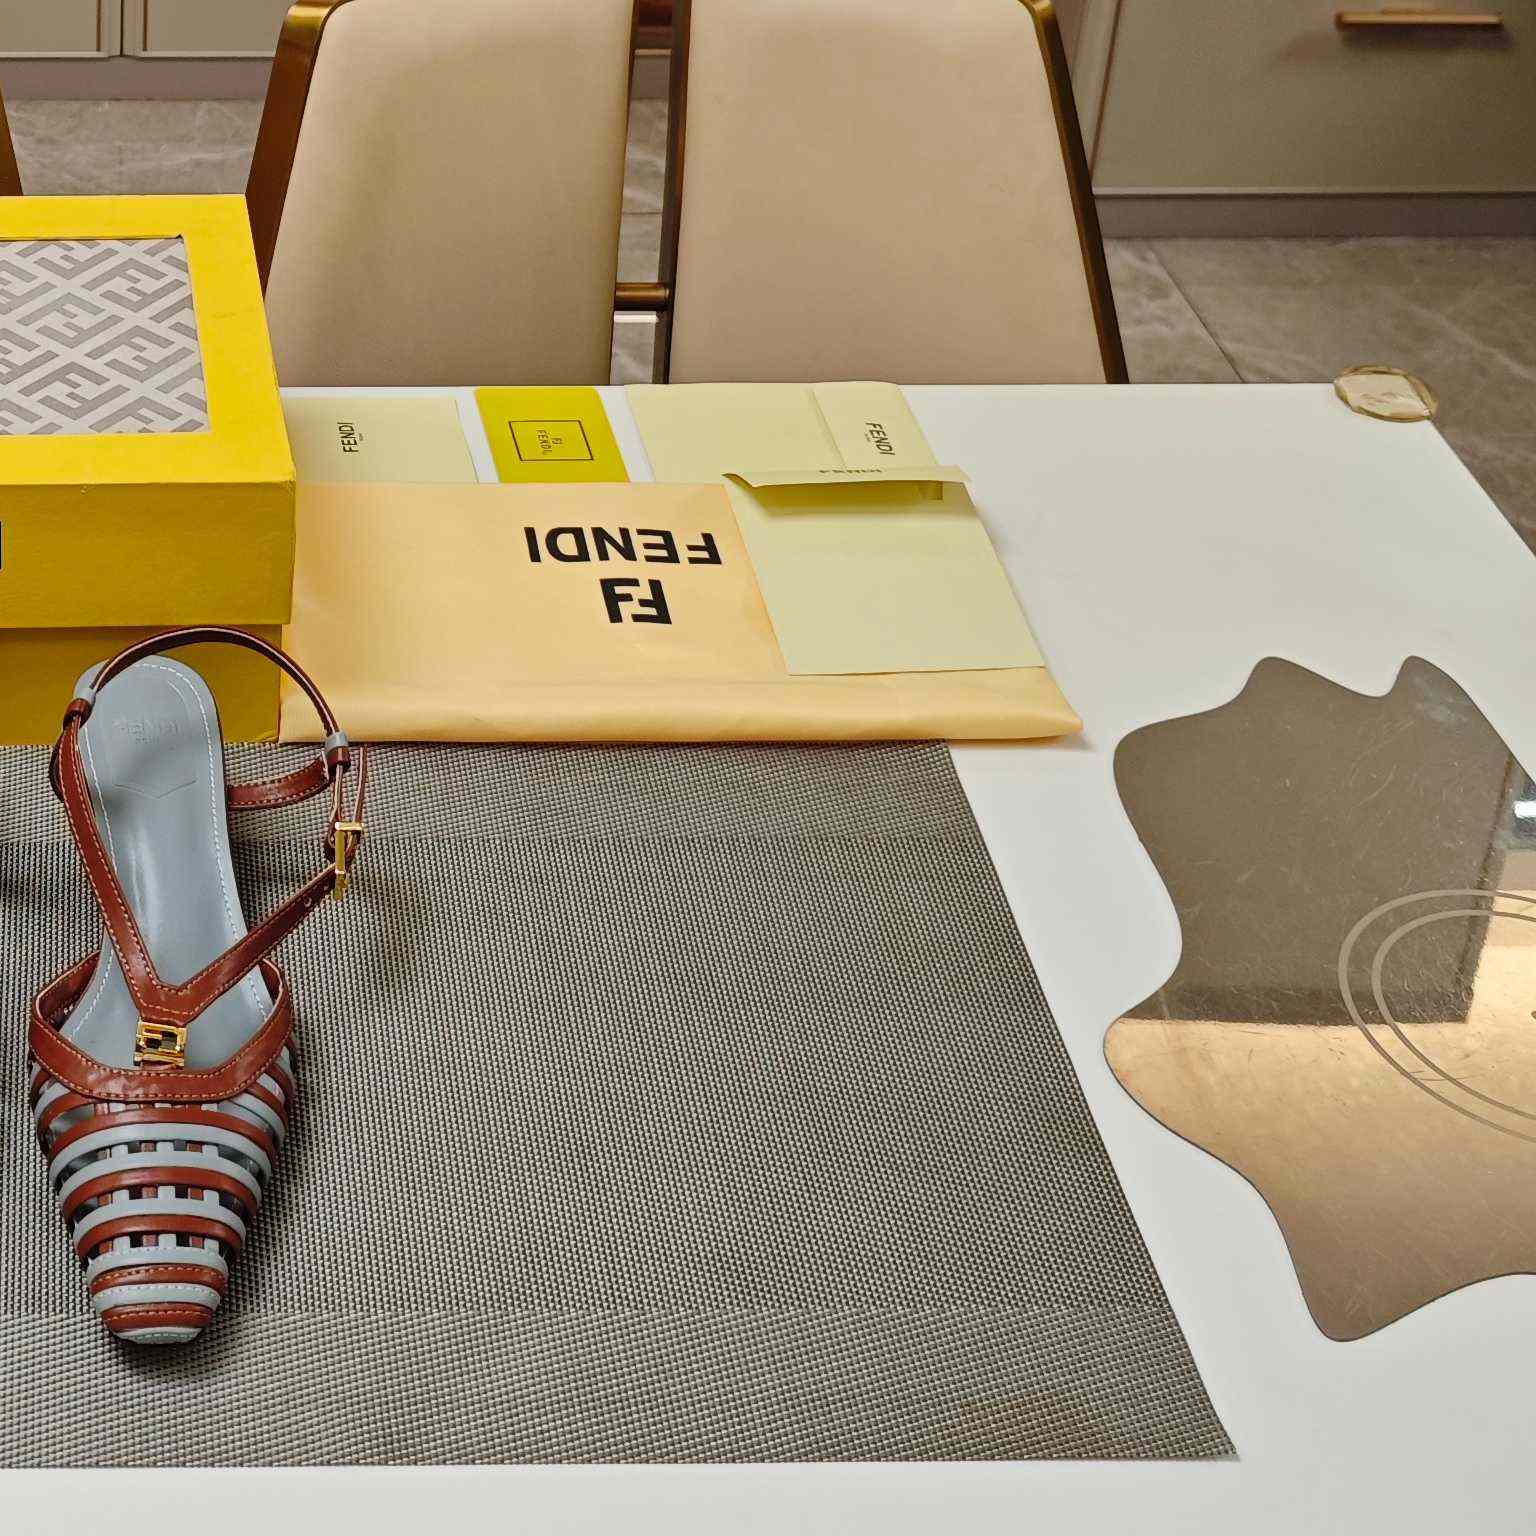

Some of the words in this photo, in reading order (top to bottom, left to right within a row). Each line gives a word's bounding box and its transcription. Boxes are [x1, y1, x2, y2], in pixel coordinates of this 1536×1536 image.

[336, 422, 359, 453] FENDI
[865, 422, 895, 456] FENDI
[523, 526, 722, 565] FENDI
